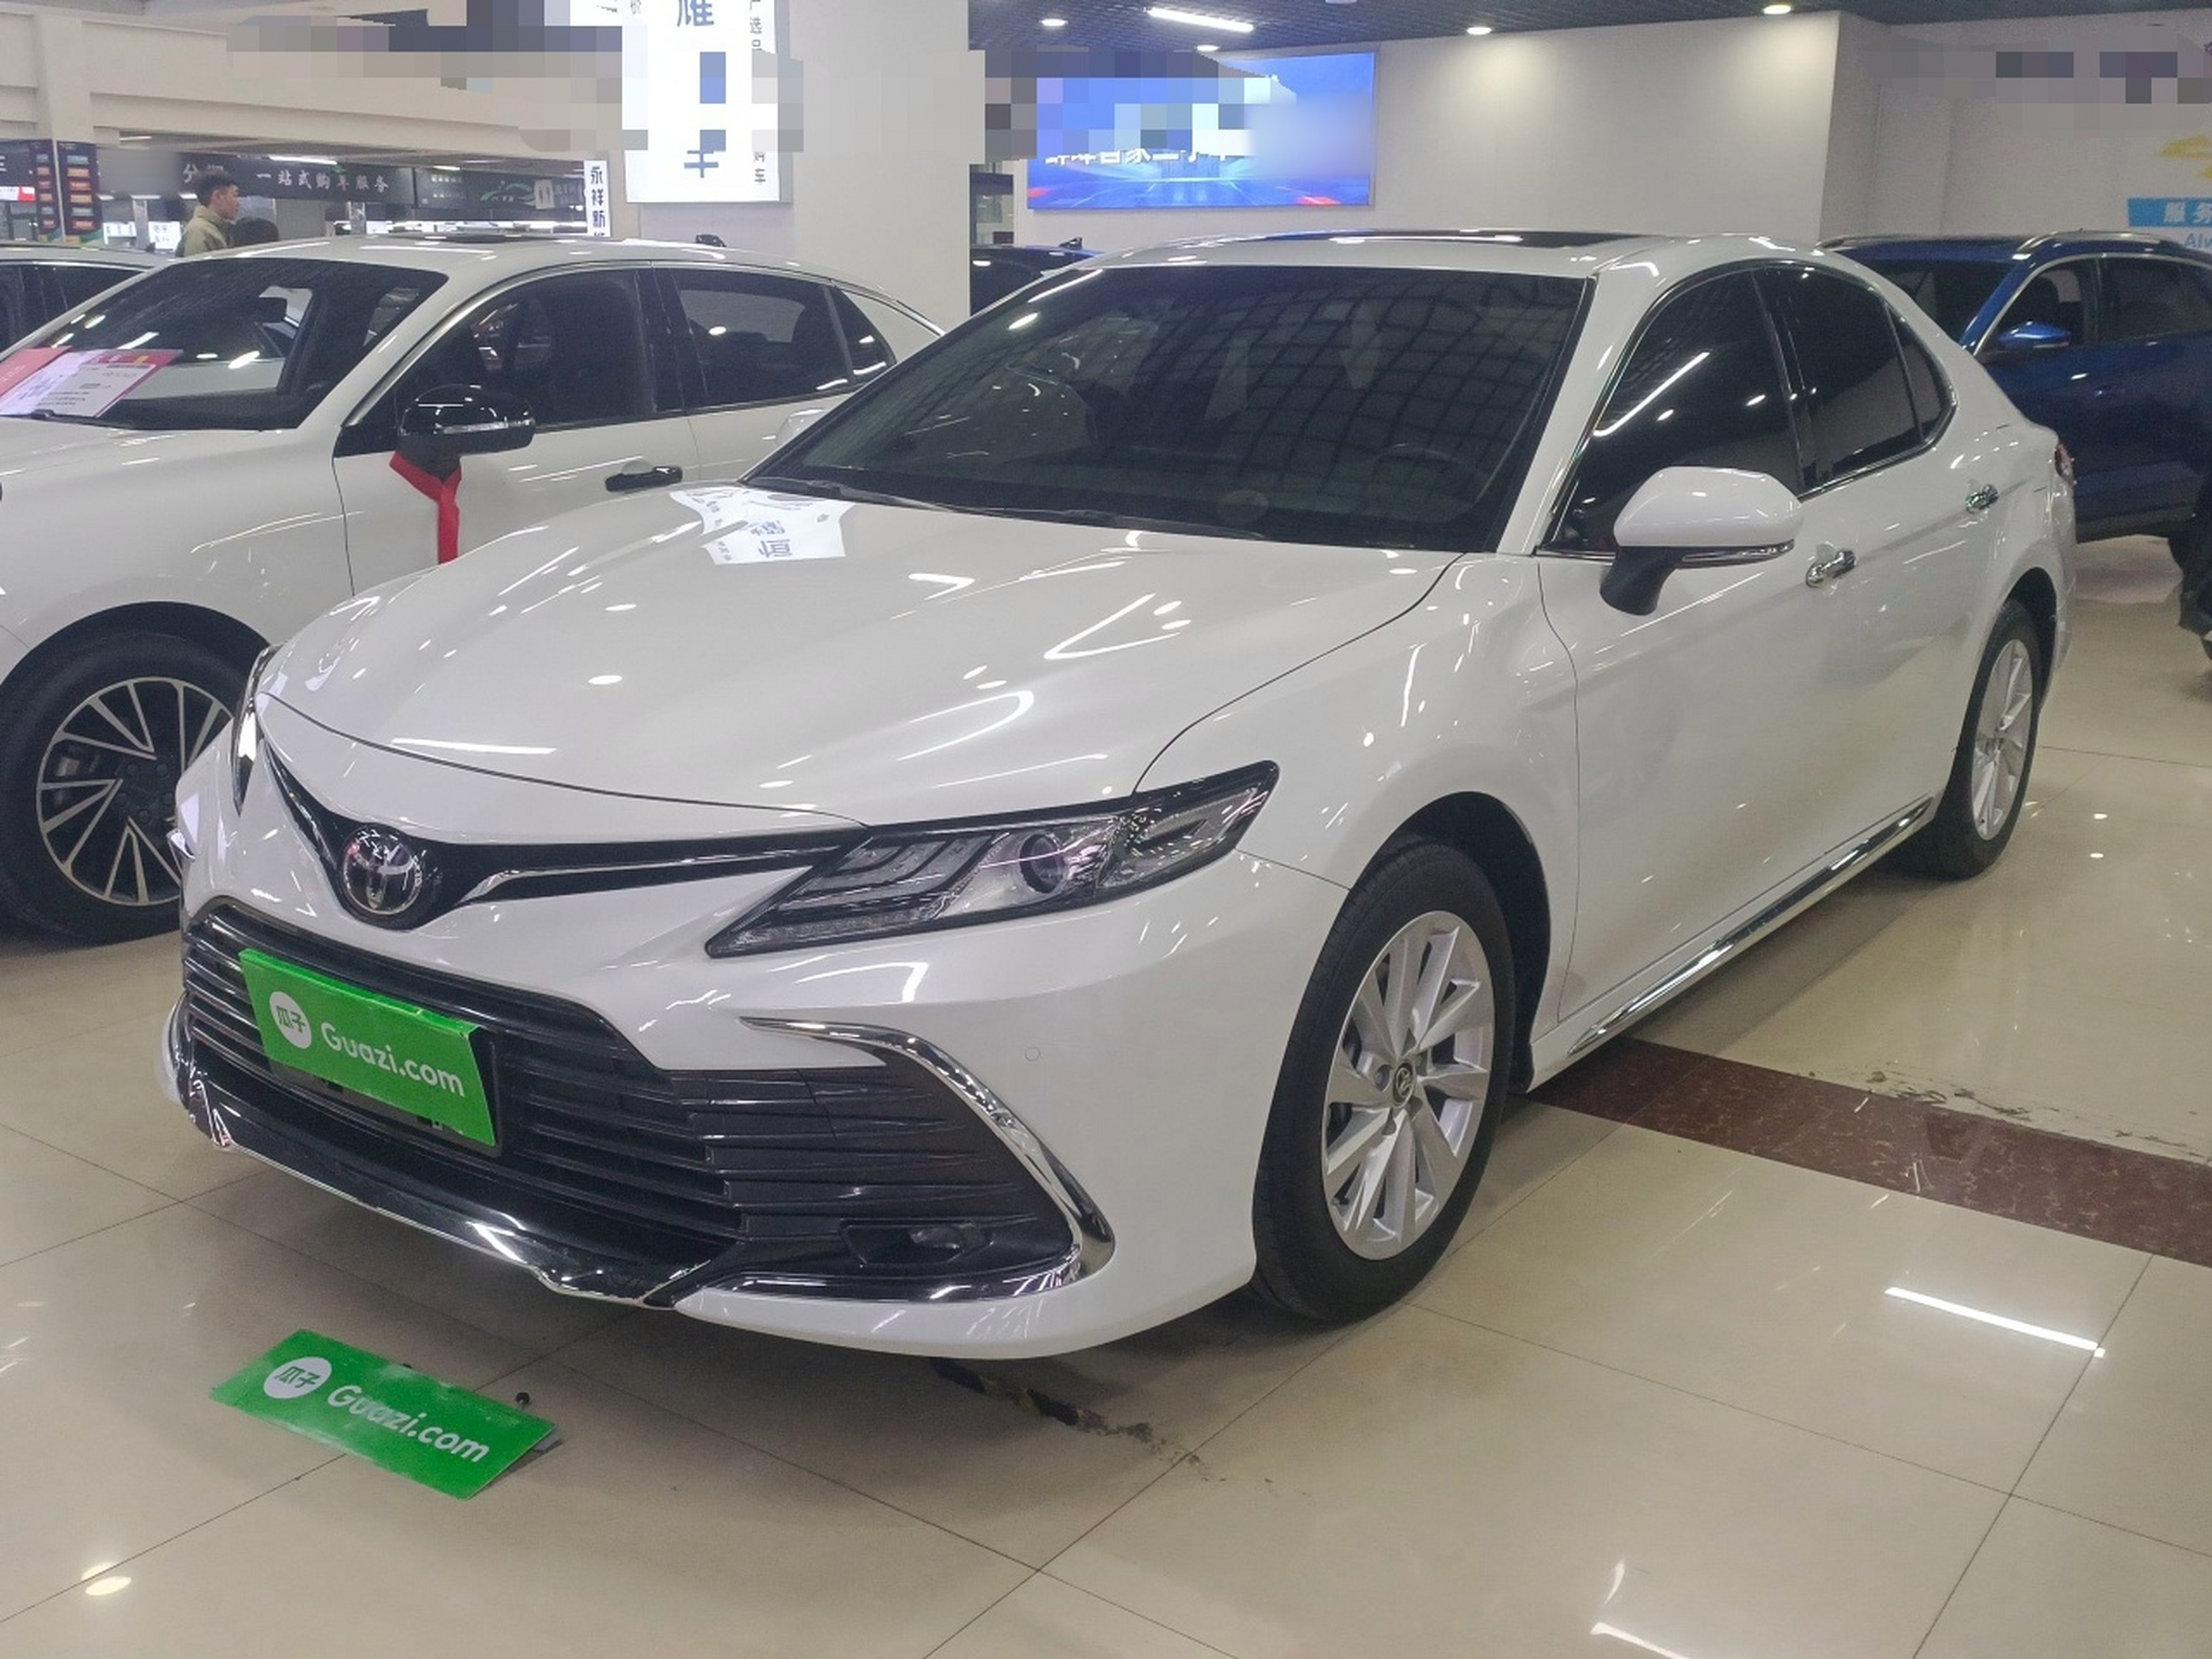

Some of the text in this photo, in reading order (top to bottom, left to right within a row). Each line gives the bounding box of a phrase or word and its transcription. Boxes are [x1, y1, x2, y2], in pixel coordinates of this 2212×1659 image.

[276, 1005, 307, 1033] 瓜子
[321, 1022, 465, 1097] Guazi.com
[274, 1366, 320, 1389] 瓜子
[327, 1385, 490, 1463] Guazi.com
